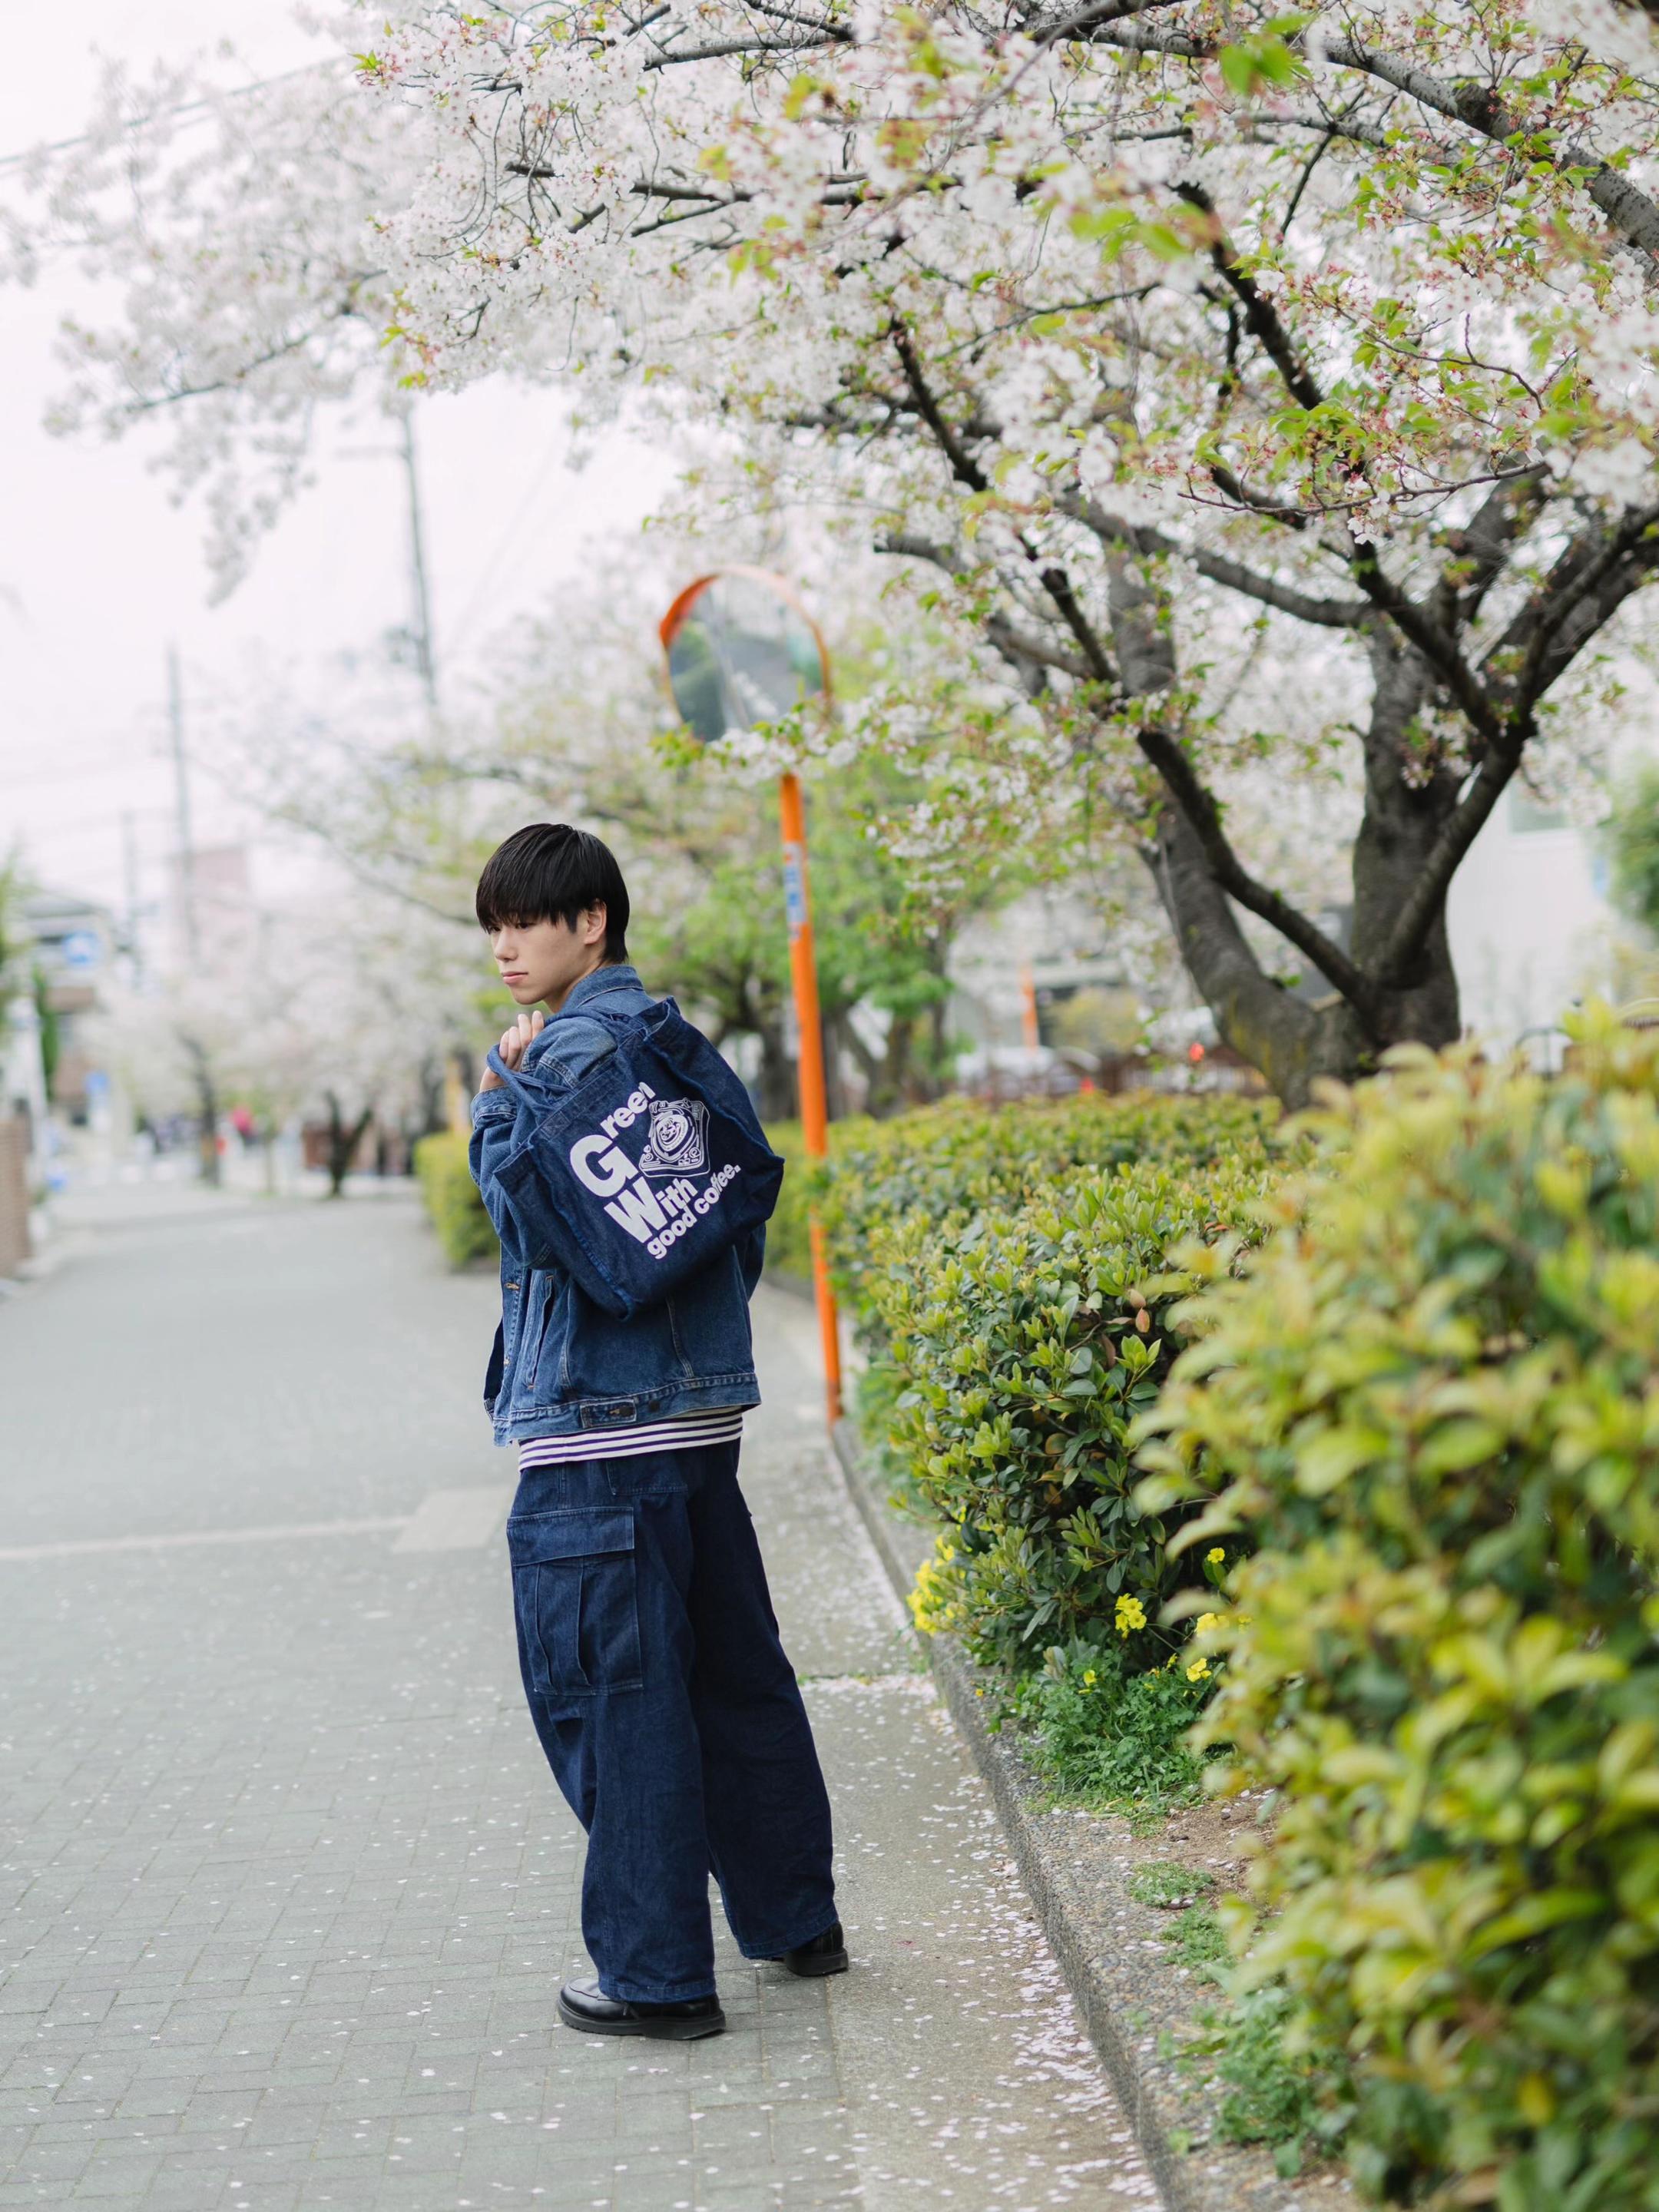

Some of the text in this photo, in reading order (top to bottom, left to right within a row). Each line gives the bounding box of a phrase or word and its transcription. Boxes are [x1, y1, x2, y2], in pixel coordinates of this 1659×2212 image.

[604, 1176, 698, 1243] With
[647, 1164, 741, 1260] good coffee.
